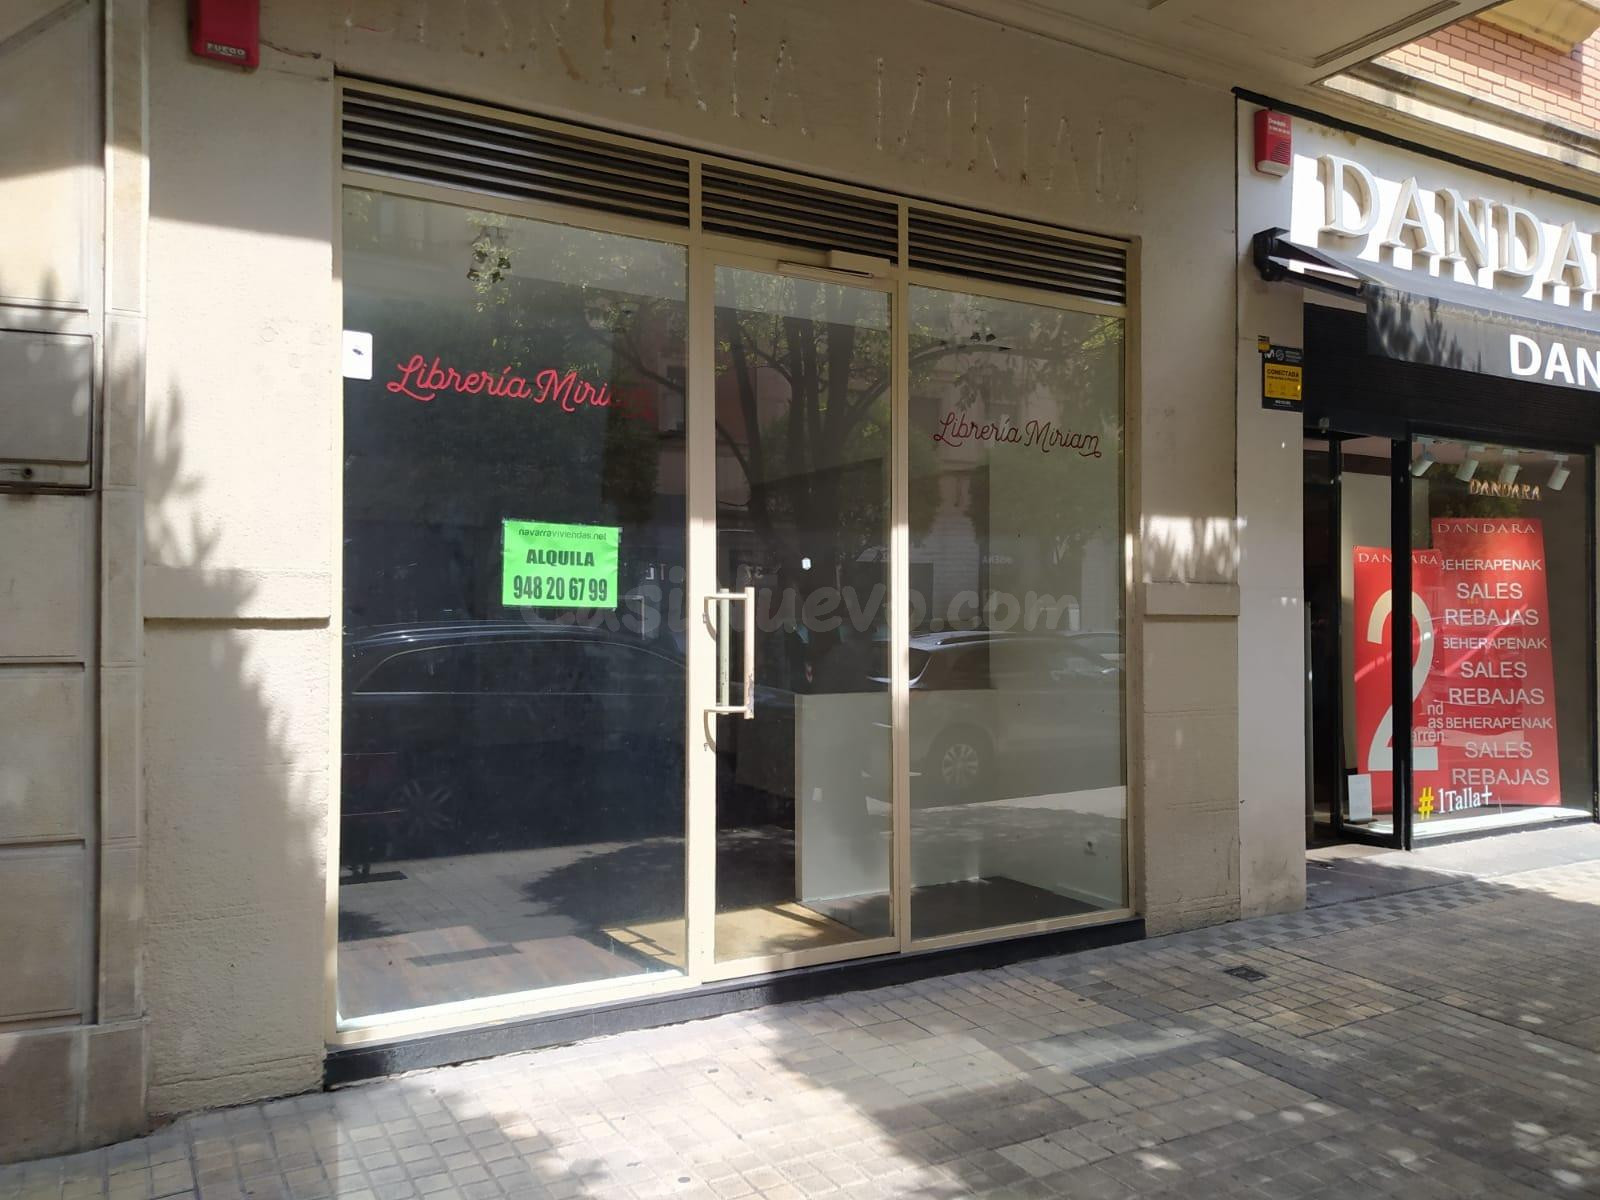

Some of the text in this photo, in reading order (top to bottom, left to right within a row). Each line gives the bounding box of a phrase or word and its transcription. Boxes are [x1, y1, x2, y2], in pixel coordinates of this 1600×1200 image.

[1316, 153, 1600, 294] DANDA
[1509, 333, 1600, 389] DAN
[386, 354, 640, 416] Librería Miri
[933, 411, 1102, 458] Librería Miriam
[1469, 479, 1541, 500] DANDARA
[518, 528, 607, 541] navarraviviendas.net
[1437, 523, 1536, 534] DANDARA
[526, 549, 595, 567] ALQUILA
[1359, 552, 1438, 565] DANARA
[1441, 559, 1542, 571] BEHERAPENAK
[513, 575, 608, 602] 948 20 67 99
[1456, 582, 1523, 600] SALES
[1444, 608, 1540, 626] REBAJAS
[1443, 637, 1548, 649] BEHERAPENAK
[1460, 661, 1528, 679] SALES
[1448, 687, 1545, 705] REBAJAS
[1446, 717, 1553, 729] BEHERAPENAK
[1411, 730, 1445, 742] arren
[1465, 741, 1533, 759] SALES
[1452, 768, 1550, 785] REBAJAS
